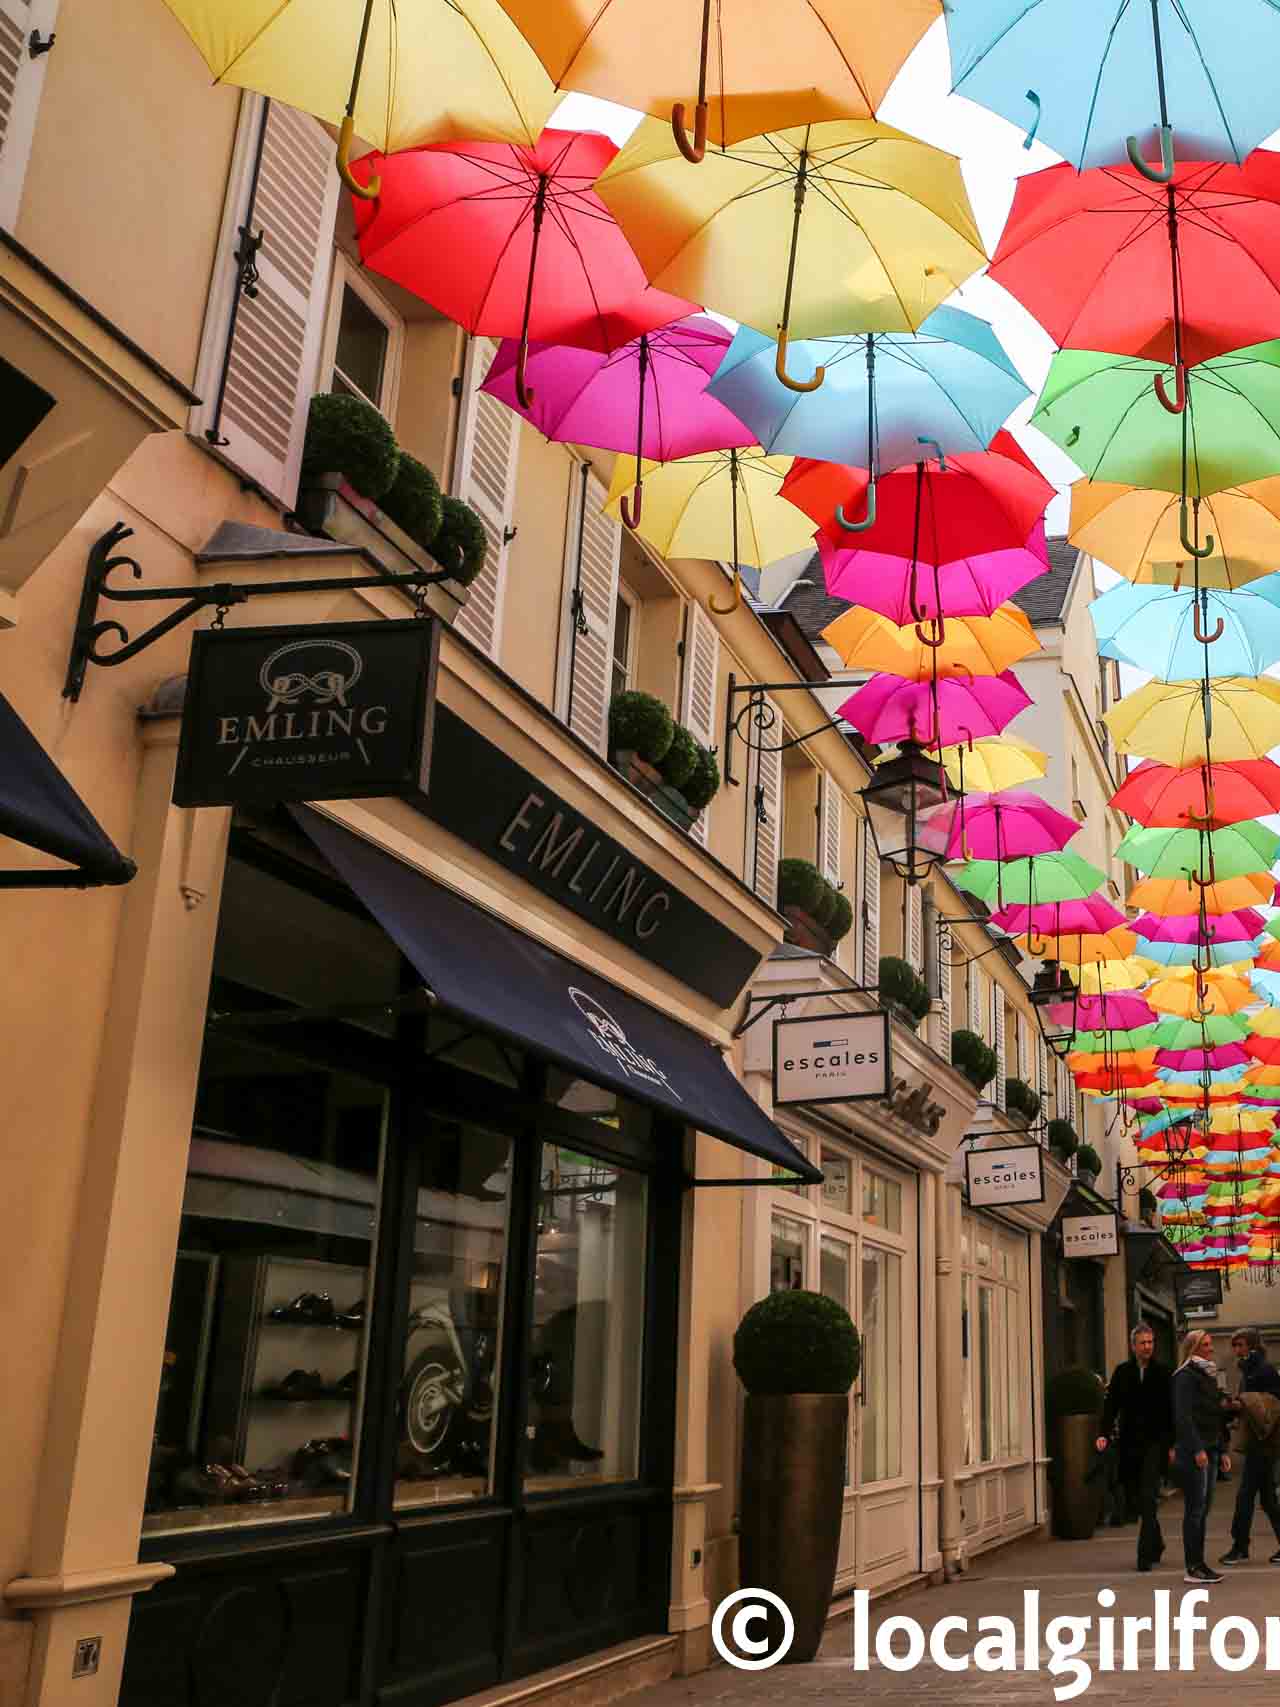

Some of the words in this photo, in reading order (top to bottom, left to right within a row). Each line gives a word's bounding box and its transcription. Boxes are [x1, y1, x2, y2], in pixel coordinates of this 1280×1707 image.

[215, 705, 387, 745] EMLING
[251, 751, 351, 767] CHAUSSEUR
[783, 1051, 879, 1071] escales
[974, 1170, 1037, 1185] escales
[1065, 1231, 1114, 1243] escales
